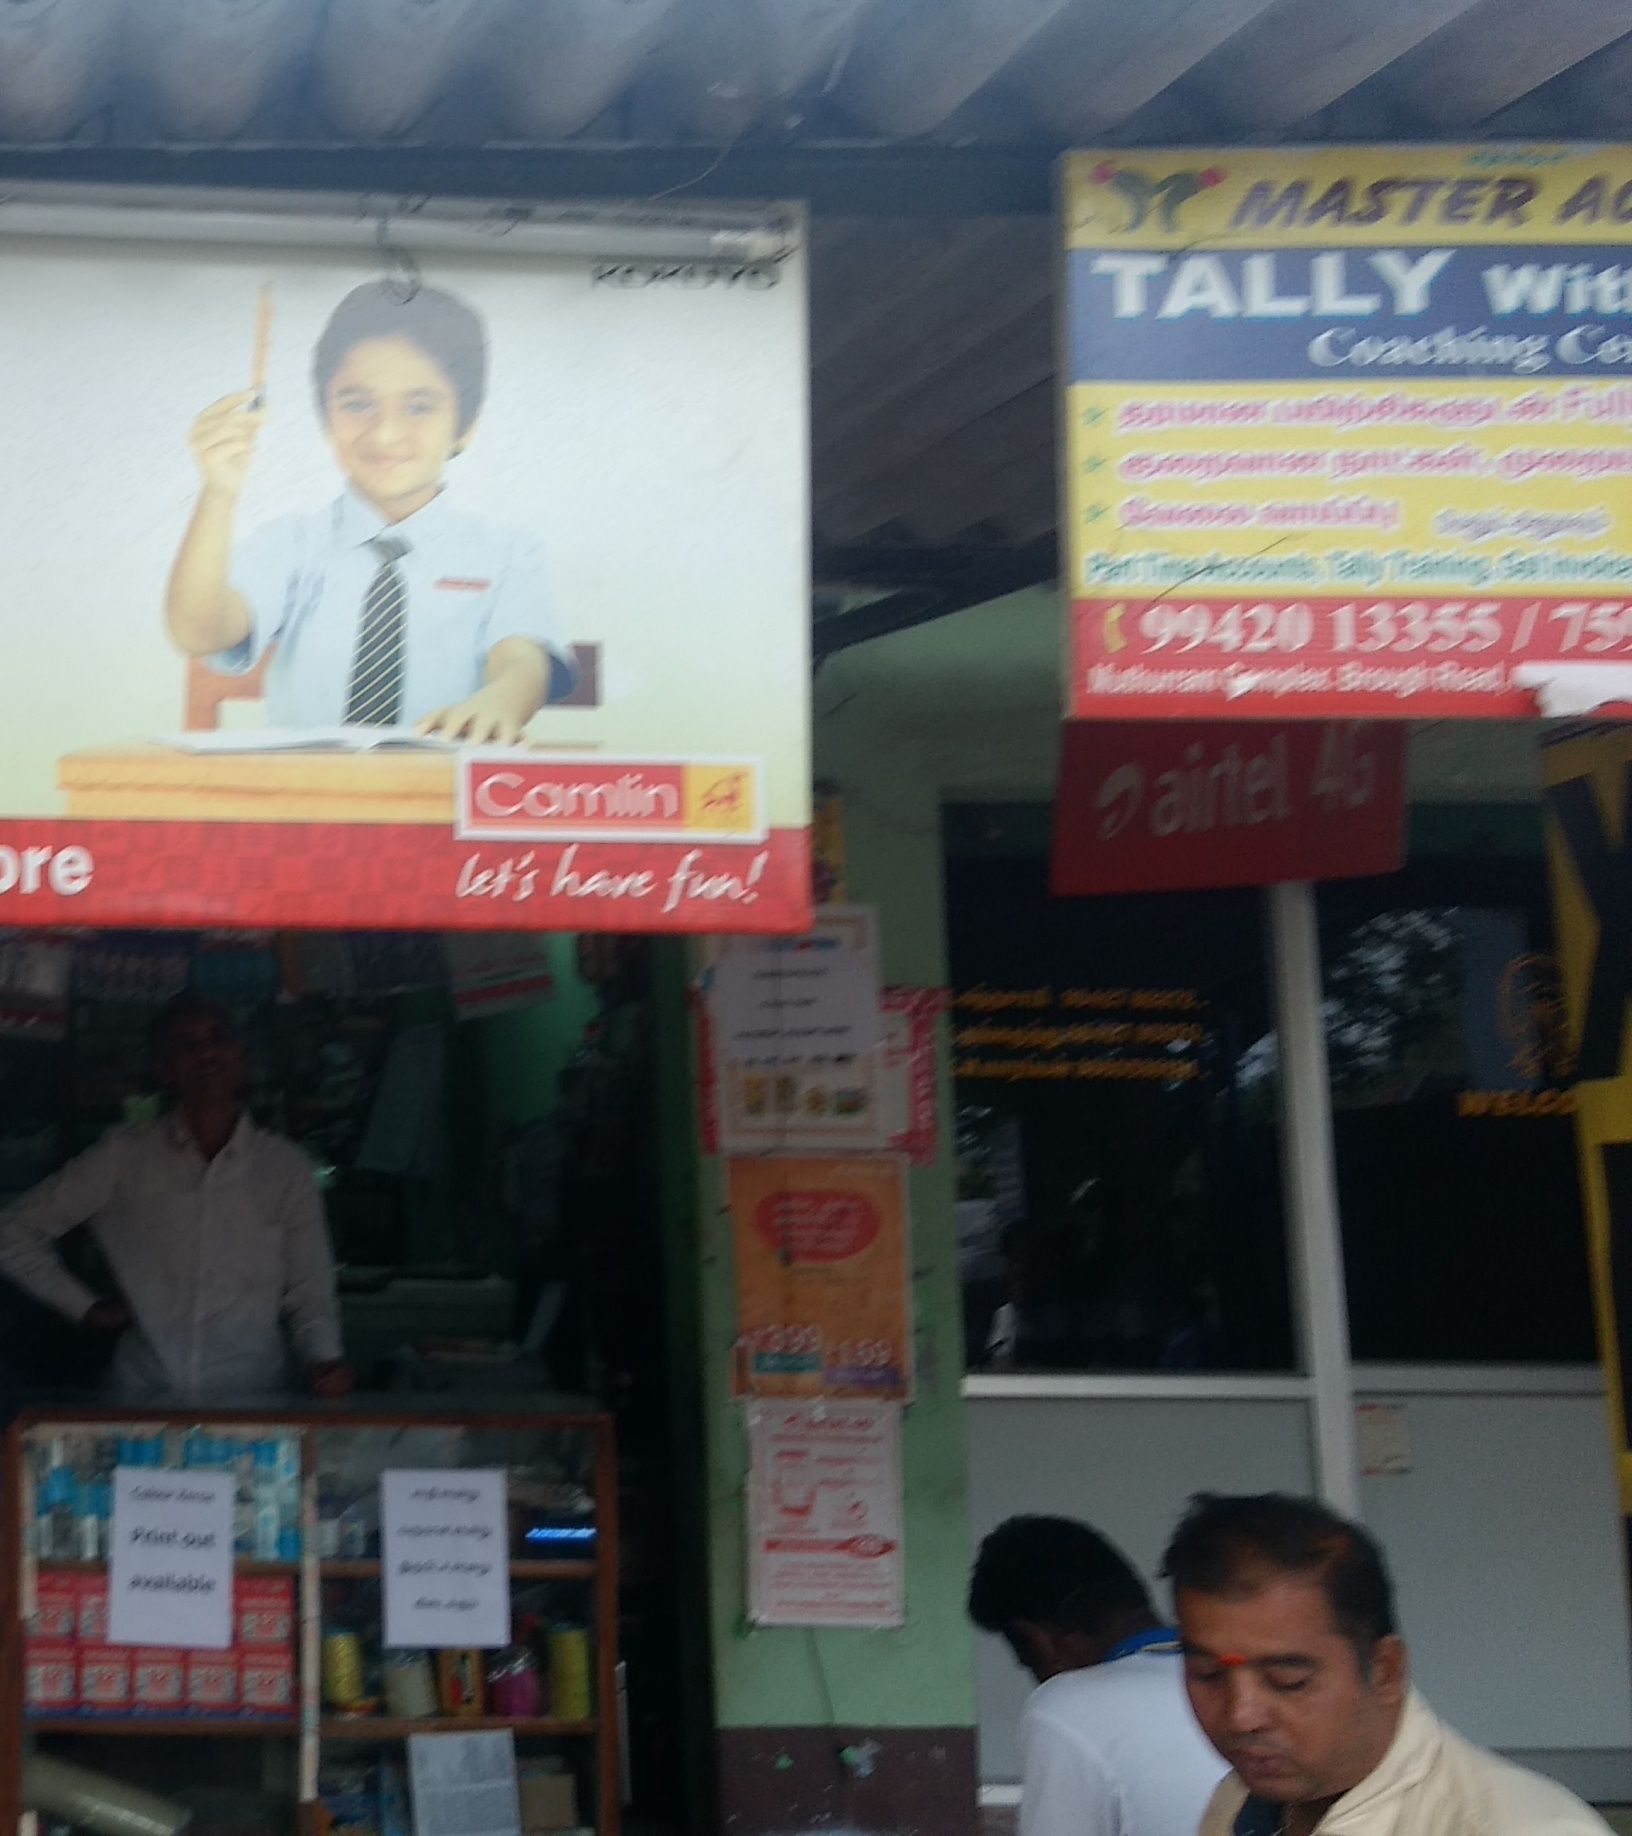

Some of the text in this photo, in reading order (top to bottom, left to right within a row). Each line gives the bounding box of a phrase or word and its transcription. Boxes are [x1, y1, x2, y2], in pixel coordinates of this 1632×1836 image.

[1230, 172, 1542, 229] MASTER
[1090, 248, 1456, 319] TALLY
[1307, 325, 1551, 375] Coaching
[1139, 602, 1315, 655] 99420
[1326, 602, 1503, 654] 13355
[1508, 602, 1543, 655] /
[474, 771, 679, 818] Camlin
[1145, 732, 1292, 838] airtel
[455, 842, 770, 914] let's have fun!
